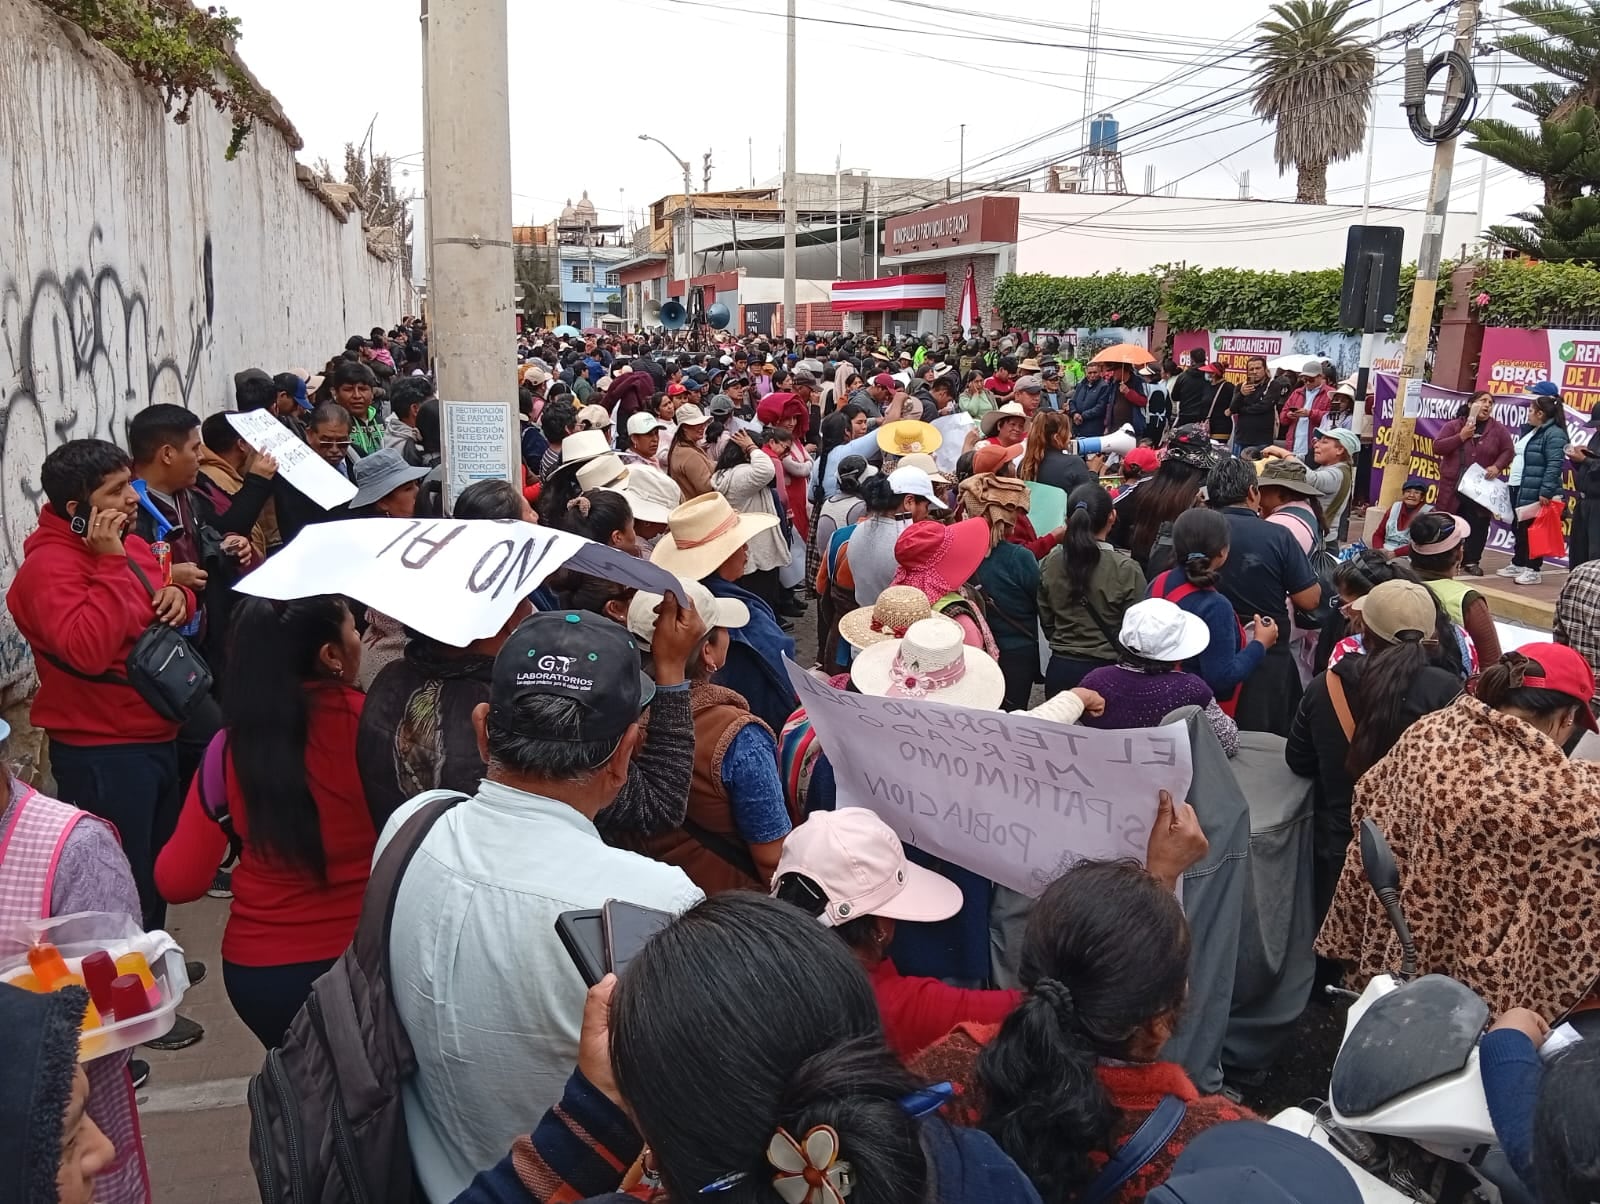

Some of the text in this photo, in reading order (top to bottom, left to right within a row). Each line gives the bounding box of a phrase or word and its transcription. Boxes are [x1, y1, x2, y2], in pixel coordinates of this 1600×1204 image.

[922, 219, 945, 240] PROVINCIAL
[946, 217, 953, 236] DE
[1222, 338, 1280, 354] MEJORAMIENTO
[1234, 355, 1248, 369] BOS
[1492, 366, 1548, 386] OBRAS
[1566, 366, 1586, 386] DE
[456, 406, 504, 414] RECTIFICACIÓN
[1564, 390, 1600, 412] OLÍM
[457, 426, 504, 434] SUCESIÓN
[465, 534, 560, 602] NO
[516, 672, 594, 686] LABORATORIOS
